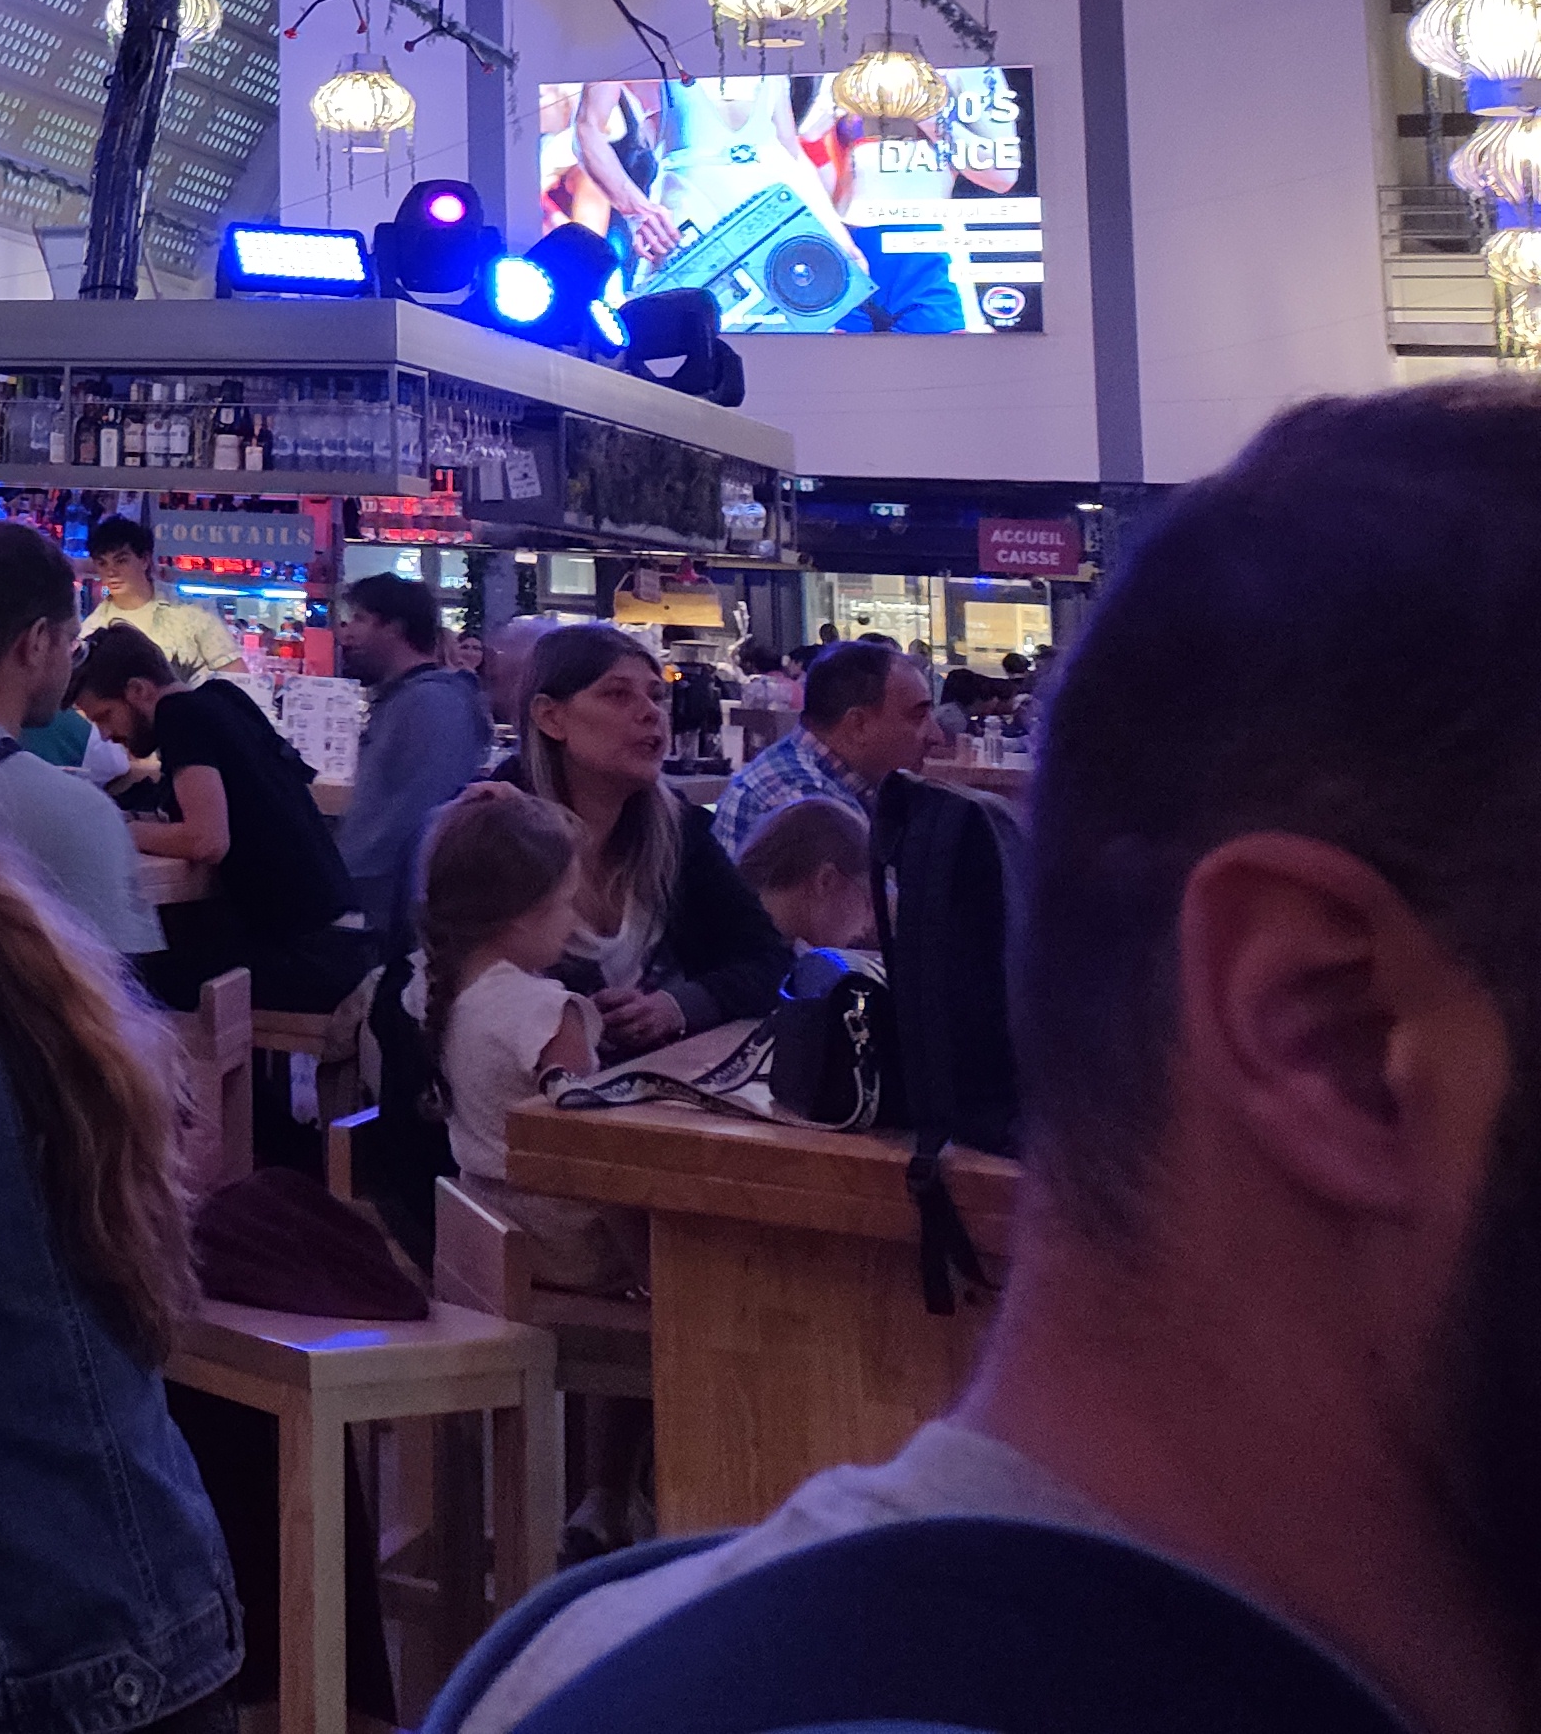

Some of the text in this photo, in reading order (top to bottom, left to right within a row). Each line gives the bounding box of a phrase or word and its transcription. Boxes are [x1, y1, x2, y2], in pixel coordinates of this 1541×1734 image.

[880, 136, 1022, 174] DANCE
[154, 523, 312, 546] COCKTAILS
[990, 529, 1065, 546] ACCUEIL
[996, 549, 1060, 566] CAISSE
